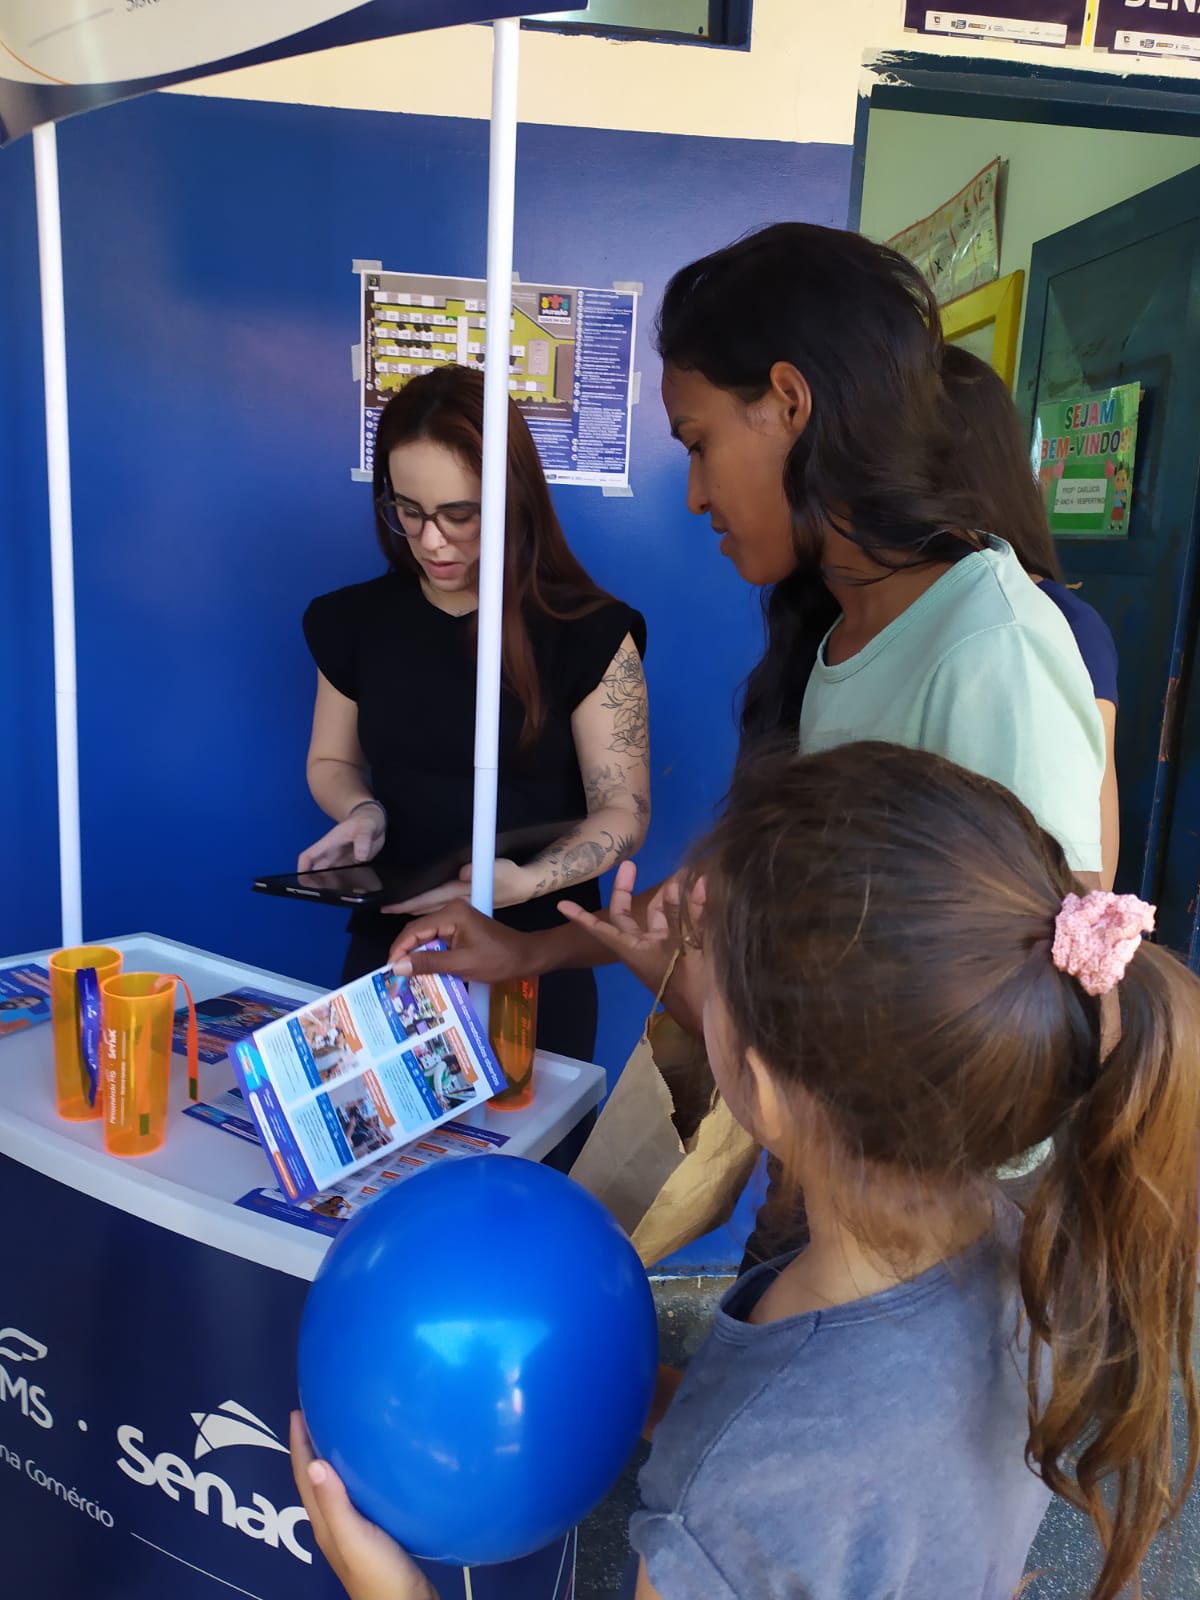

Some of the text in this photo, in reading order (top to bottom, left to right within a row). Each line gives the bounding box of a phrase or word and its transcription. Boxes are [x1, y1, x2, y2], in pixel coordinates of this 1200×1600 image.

[1065, 399, 1115, 430] SEJAM
[450, 978, 464, 1005] cursos
[461, 1004, 472, 1022] com
[483, 1055, 500, 1087] abertas
[0, 1364, 313, 1564] MS Senac
[25, 1460, 114, 1528] Comércio
